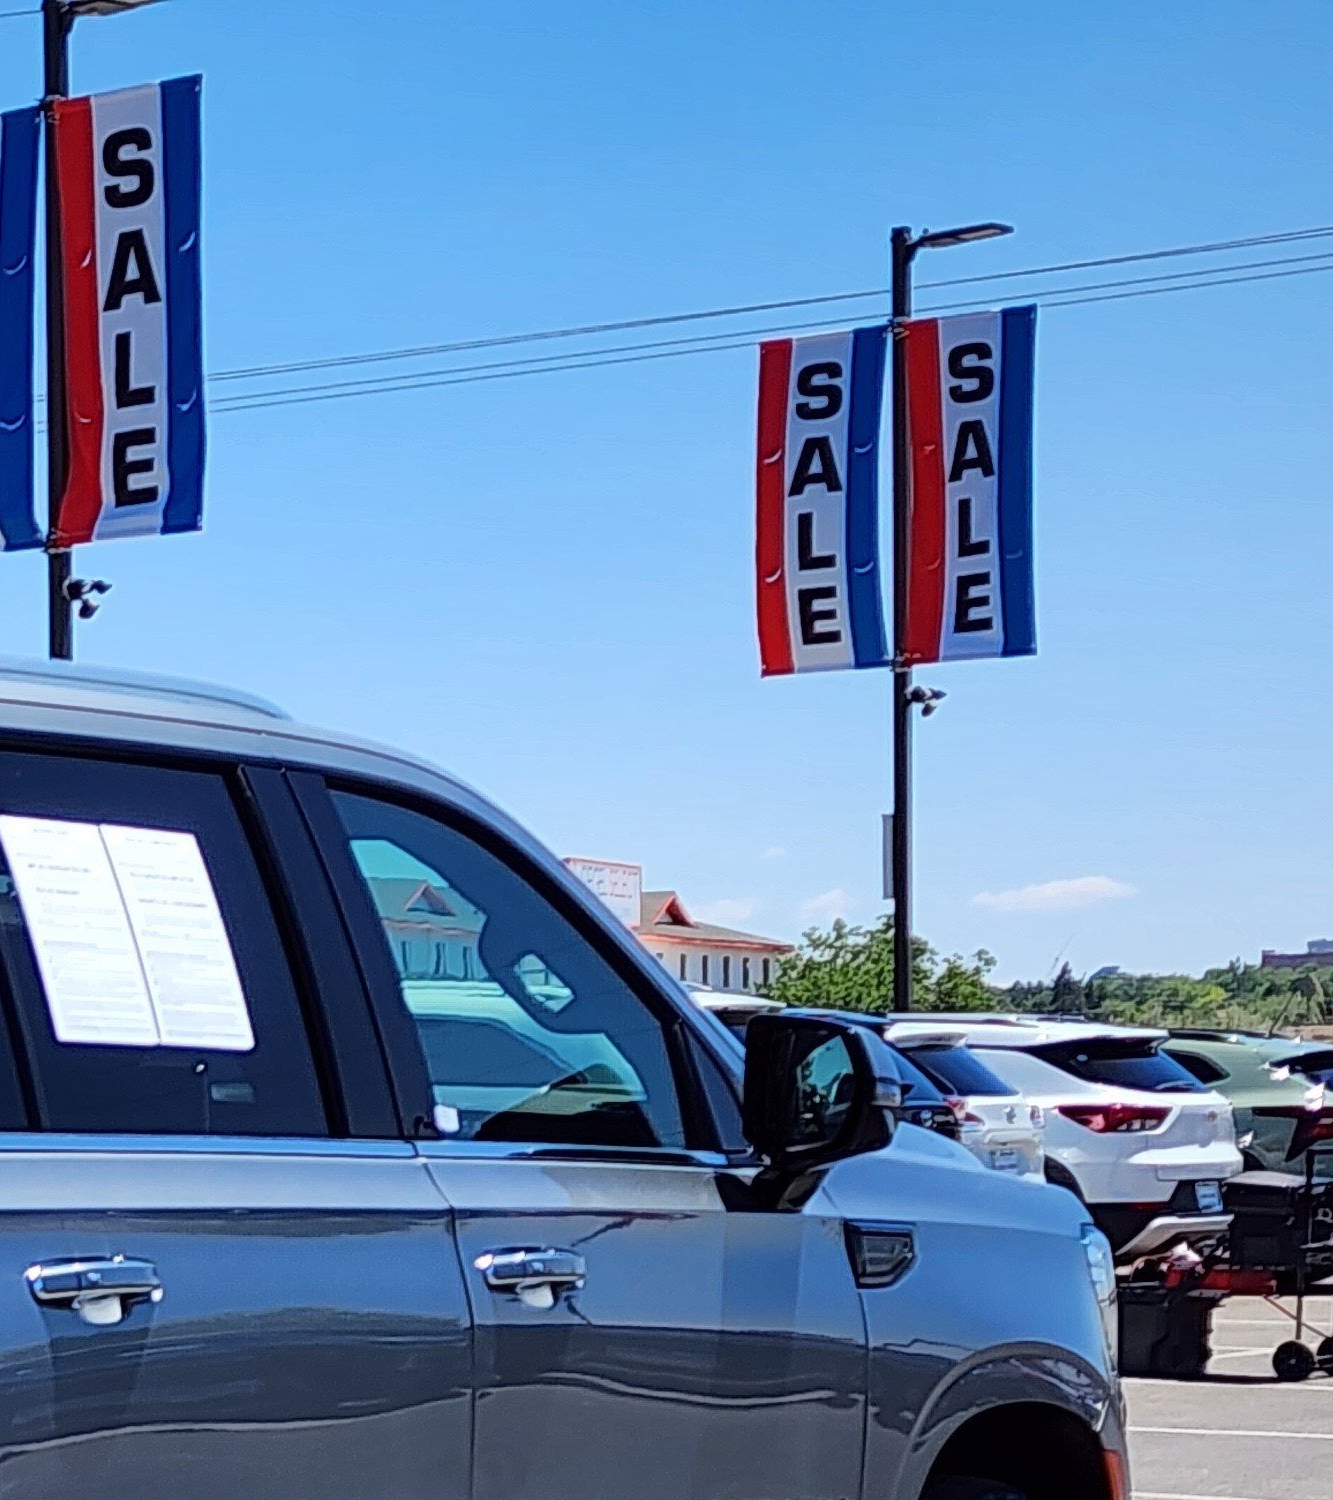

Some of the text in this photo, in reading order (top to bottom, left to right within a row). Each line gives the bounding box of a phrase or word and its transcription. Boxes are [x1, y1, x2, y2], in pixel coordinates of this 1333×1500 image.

[101, 126, 163, 508] SALE
[787, 362, 844, 646] SALE
[948, 342, 995, 635] SALE
